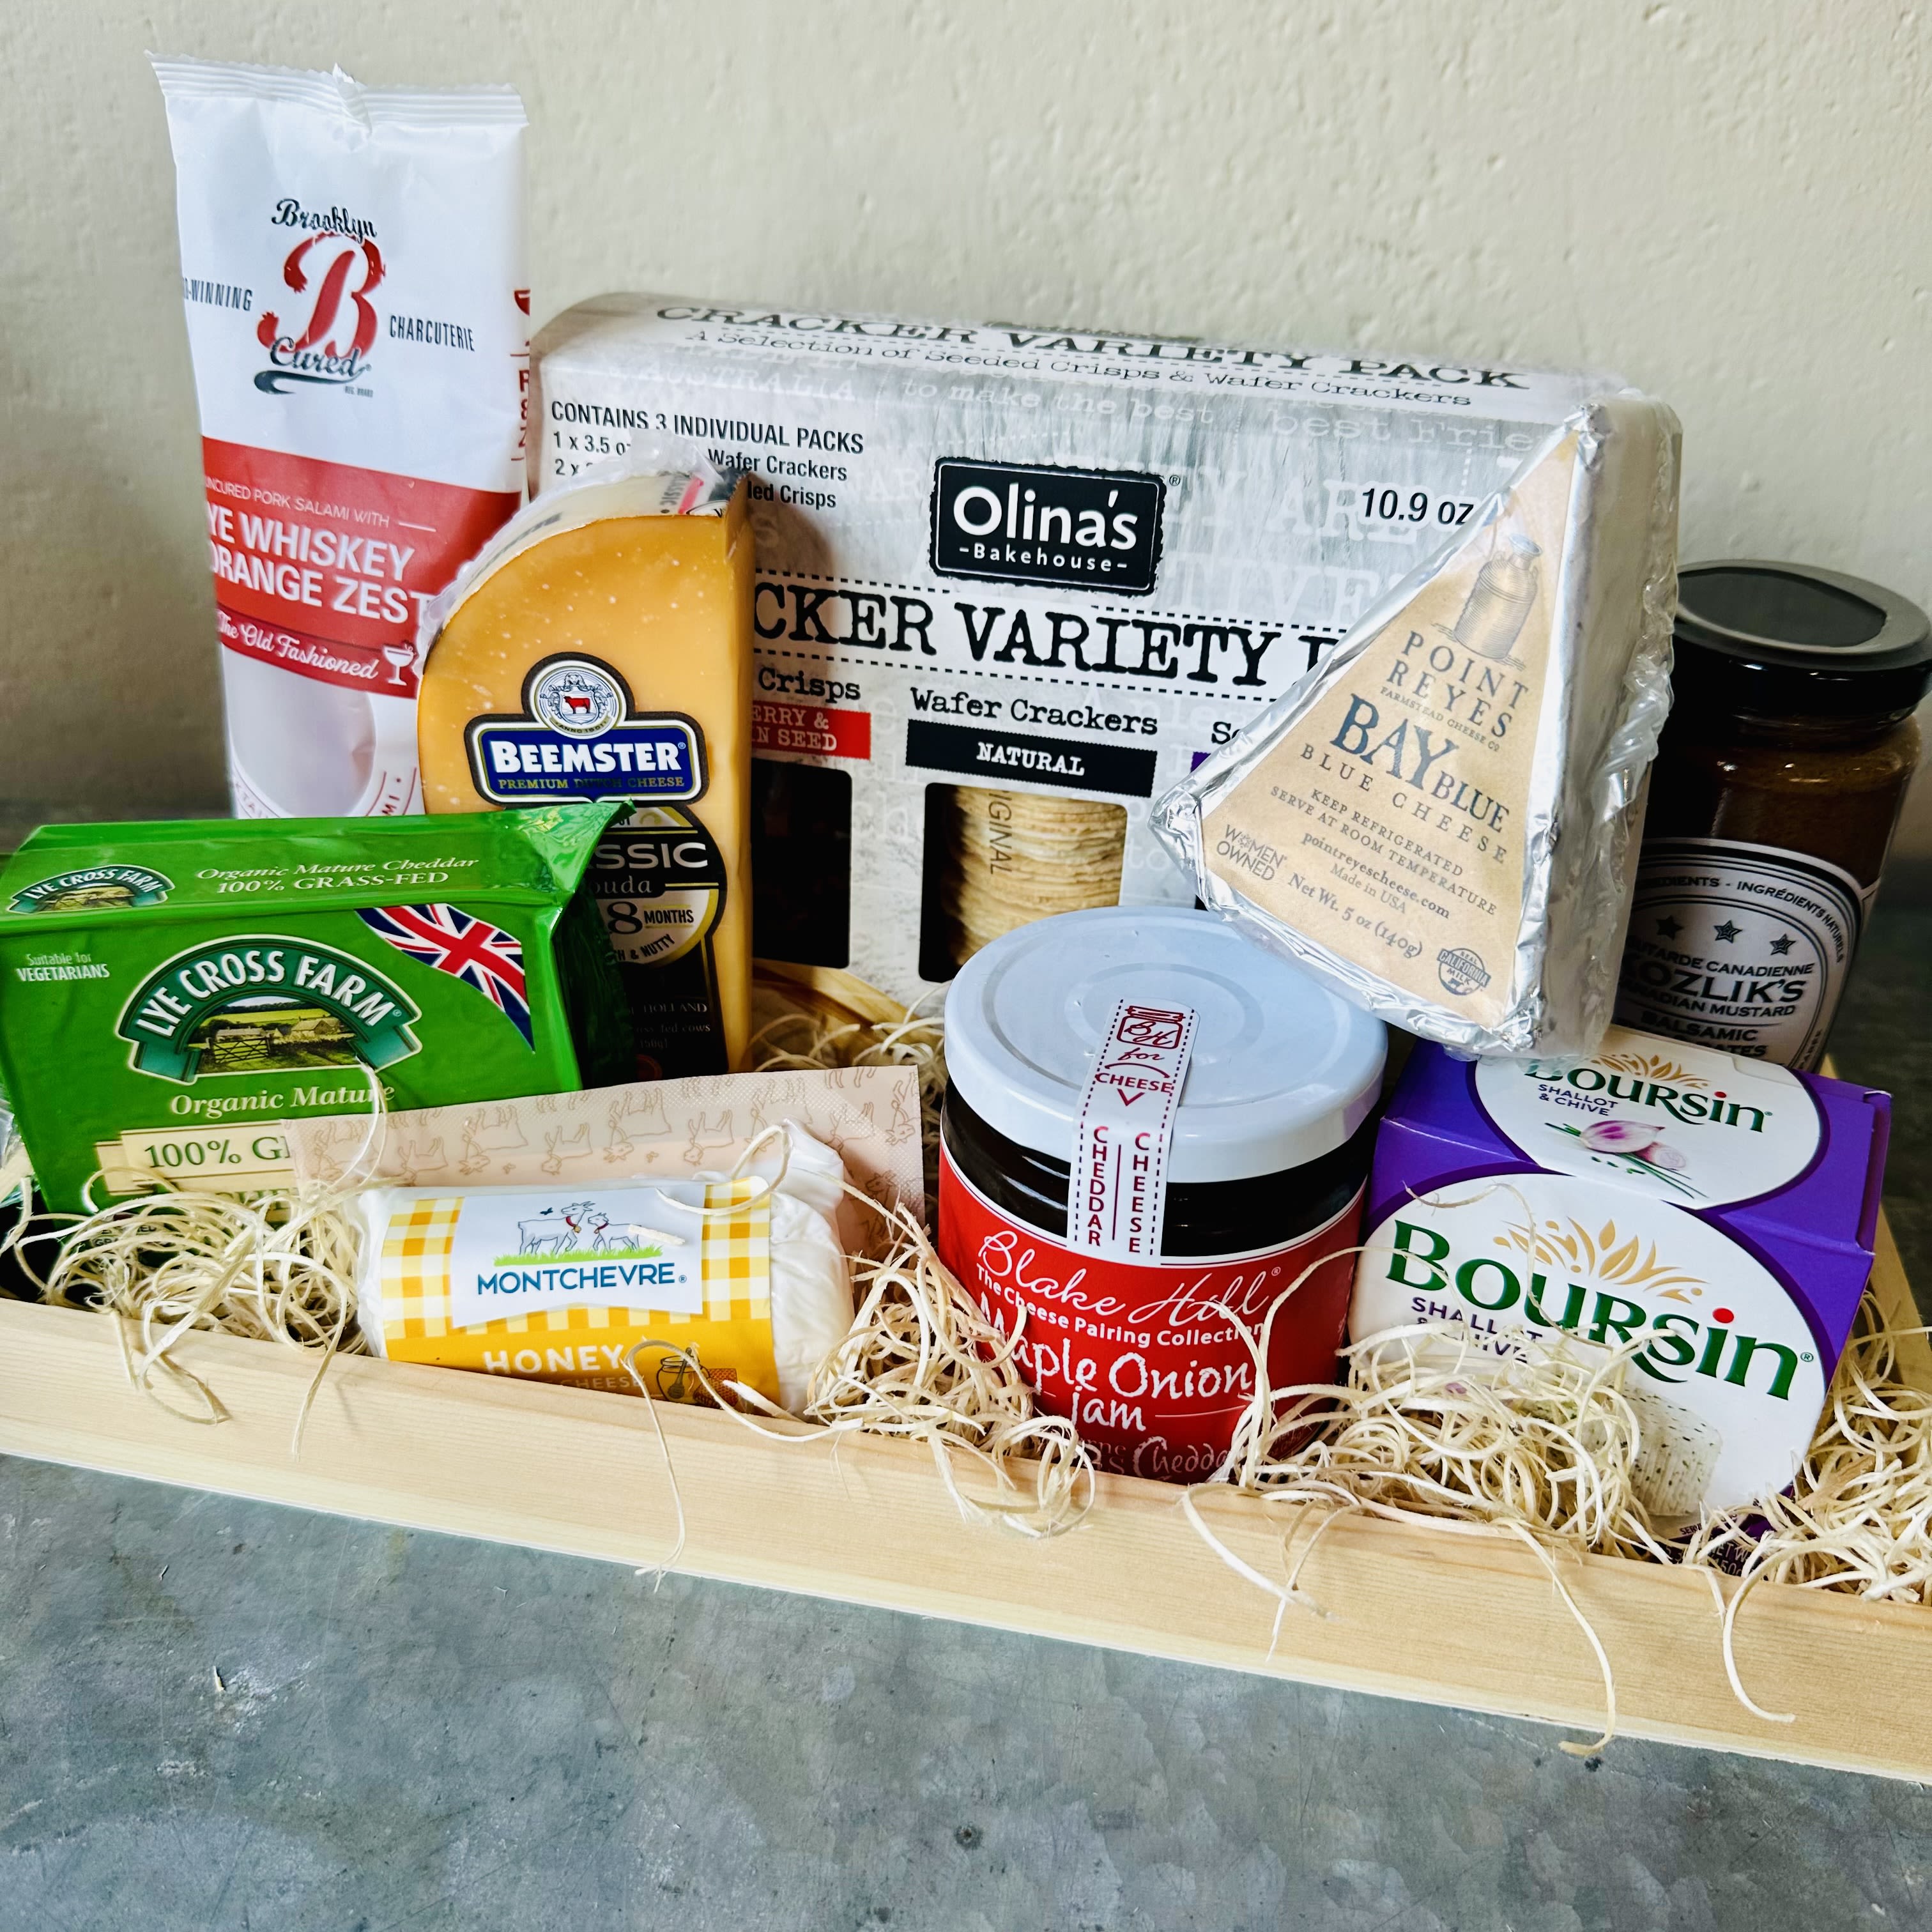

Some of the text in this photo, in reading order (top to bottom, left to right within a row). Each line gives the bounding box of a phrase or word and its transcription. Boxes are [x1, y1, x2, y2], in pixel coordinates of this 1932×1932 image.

[272, 199, 377, 244] Brooklyn
[390, 314, 475, 353] CHARCUTERIE
[656, 307, 1531, 390] CRACKER VARIETY PACK
[270, 336, 362, 377] Cured
[686, 330, 709, 342] A
[717, 332, 873, 357] Selection
[882, 346, 921, 360] of
[924, 351, 1039, 371] Seeded
[1050, 360, 1160, 380] Crisps
[1169, 369, 1194, 383] &
[1204, 371, 1303, 392] Wafer
[1310, 380, 1472, 406] Crackers
[551, 400, 864, 455] CONTAINS 3 INDIVIDUAL PACKS
[553, 431, 631, 456] 1 x 3.5 o
[555, 457, 566, 477] 2
[708, 447, 848, 481] Wafer Crackers
[254, 489, 291, 509] PORK
[295, 498, 350, 520] SALAMI
[349, 509, 390, 528] WITH
[779, 484, 837, 510] Crisps
[953, 481, 1139, 551] Olina's
[1361, 487, 1429, 523] 10.9
[1437, 500, 1475, 526] oz
[238, 510, 415, 581] WHISKEY
[331, 575, 440, 626] ZEST
[240, 622, 275, 652] Old
[276, 634, 379, 680] Fashioned
[953, 601, 1283, 687] VARIETY
[758, 666, 862, 704] Crisps
[1401, 630, 1529, 710] POINT
[910, 687, 1002, 719] Wafer
[1010, 698, 1159, 735] Crackers
[1380, 686, 1486, 744] FARMSTEAD CHEESE
[1386, 659, 1514, 738] REYES
[777, 728, 838, 752] SEED
[813, 711, 829, 730] &
[489, 740, 682, 774] BEEMSTER
[976, 741, 1086, 777] NATURAL
[1330, 693, 1460, 790] BAY
[1430, 770, 1510, 834] BLUE
[498, 776, 685, 790] PREMIUM DUTCH CHEESE
[1300, 742, 1508, 864] BLUE CHEESE
[1269, 785, 1498, 917] SERVE AT ROOM TEMPERATURE
[1310, 787, 1464, 877] KEEP REFRIGERATED
[195, 857, 480, 882] Organic Mature Cheddar
[1216, 840, 1276, 882] OWNED
[1300, 832, 1450, 919] pointreyescheese.com
[23, 868, 164, 900] LYE CROSS FARM
[217, 871, 449, 894] 100% GRASS-FED
[1330, 862, 1406, 914] Made in USA
[643, 908, 694, 925] MONTHS
[1287, 871, 1423, 960] Net Wt. 5 oz (140g)
[1736, 880, 1845, 963] INGRÉDIENTS NATURELS
[26, 952, 92, 966] Suitable for
[630, 949, 639, 960] &
[640, 933, 676, 958] NUTTY
[1459, 950, 1478, 965] REAL
[15, 963, 111, 982] VEGETARIANS
[1439, 949, 1489, 986] CALIFORNIA
[1446, 967, 1471, 986] MILK
[1637, 958, 1807, 1005] OZLIK'S
[1706, 960, 1816, 977] CANADIENNE
[135, 950, 396, 1038] LYE CROSS FARM
[1710, 1002, 1796, 1017] MUSTARD
[1123, 1021, 1179, 1046] BH
[1117, 1047, 1165, 1061] for
[1094, 1071, 1174, 1094] CHEESE
[1538, 1083, 1620, 1110] SHALLOT
[171, 1089, 284, 1119] Organic
[1538, 1092, 1611, 1117] & CHIVE
[144, 1138, 242, 1169] 100%
[1087, 1125, 1110, 1248] CHEDDAR
[1128, 1131, 1151, 1254] CHEESE
[477, 1262, 676, 1296] MONTCHEVRE
[976, 1229, 1270, 1328] Blake Hill
[976, 1262, 1002, 1296] The
[1003, 1285, 1071, 1330] Cheese
[1074, 1319, 1151, 1349] Pairing
[1384, 1218, 1800, 1401] Boursin
[1410, 1296, 1543, 1344] SHALLT
[483, 1344, 624, 1374] HONEY
[1108, 1351, 1253, 1399] Onion
[1072, 1384, 1147, 1432] jam
